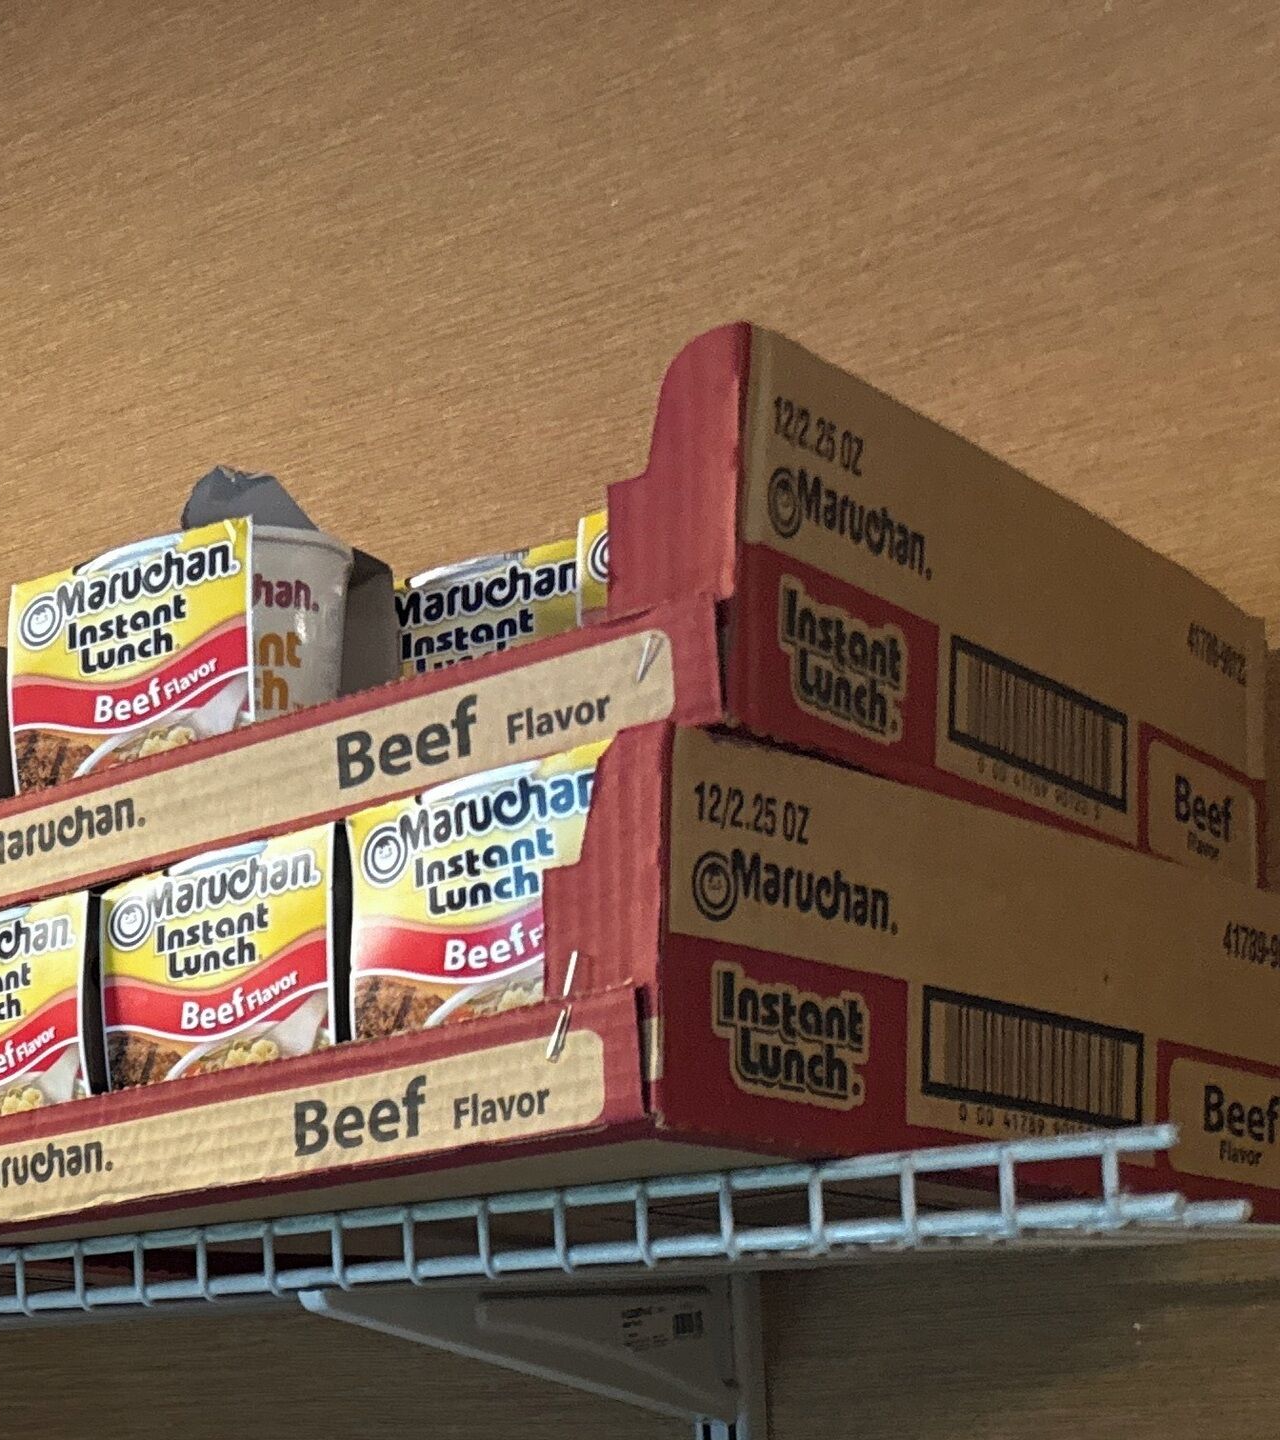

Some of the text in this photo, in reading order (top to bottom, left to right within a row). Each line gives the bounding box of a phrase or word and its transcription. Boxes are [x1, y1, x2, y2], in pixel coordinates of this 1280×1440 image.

[840, 431, 865, 477] OZ
[66, 594, 187, 650] Instant
[401, 608, 535, 661] Instant
[784, 588, 904, 680] Instant
[79, 631, 172, 676] Lunch
[93, 675, 165, 724] Beef
[163, 655, 221, 699] Flavor
[796, 653, 889, 730] Lunch
[335, 694, 611, 789] Beef Flavor
[694, 780, 811, 846] 12/2.25 OZ
[1174, 773, 1234, 843] Beef
[414, 829, 554, 889] Instant
[426, 864, 540, 917] Lunch
[154, 904, 269, 954] Instant
[443, 928, 527, 972] Beef
[166, 942, 257, 981] Lunch
[180, 970, 299, 1032] Beef Flavor
[717, 968, 866, 1052] Instant
[14, 1024, 57, 1066] Flavor
[740, 1028, 849, 1098] Lunch
[293, 1075, 551, 1157] Beef Flavor
[1203, 1083, 1280, 1145] Beef
